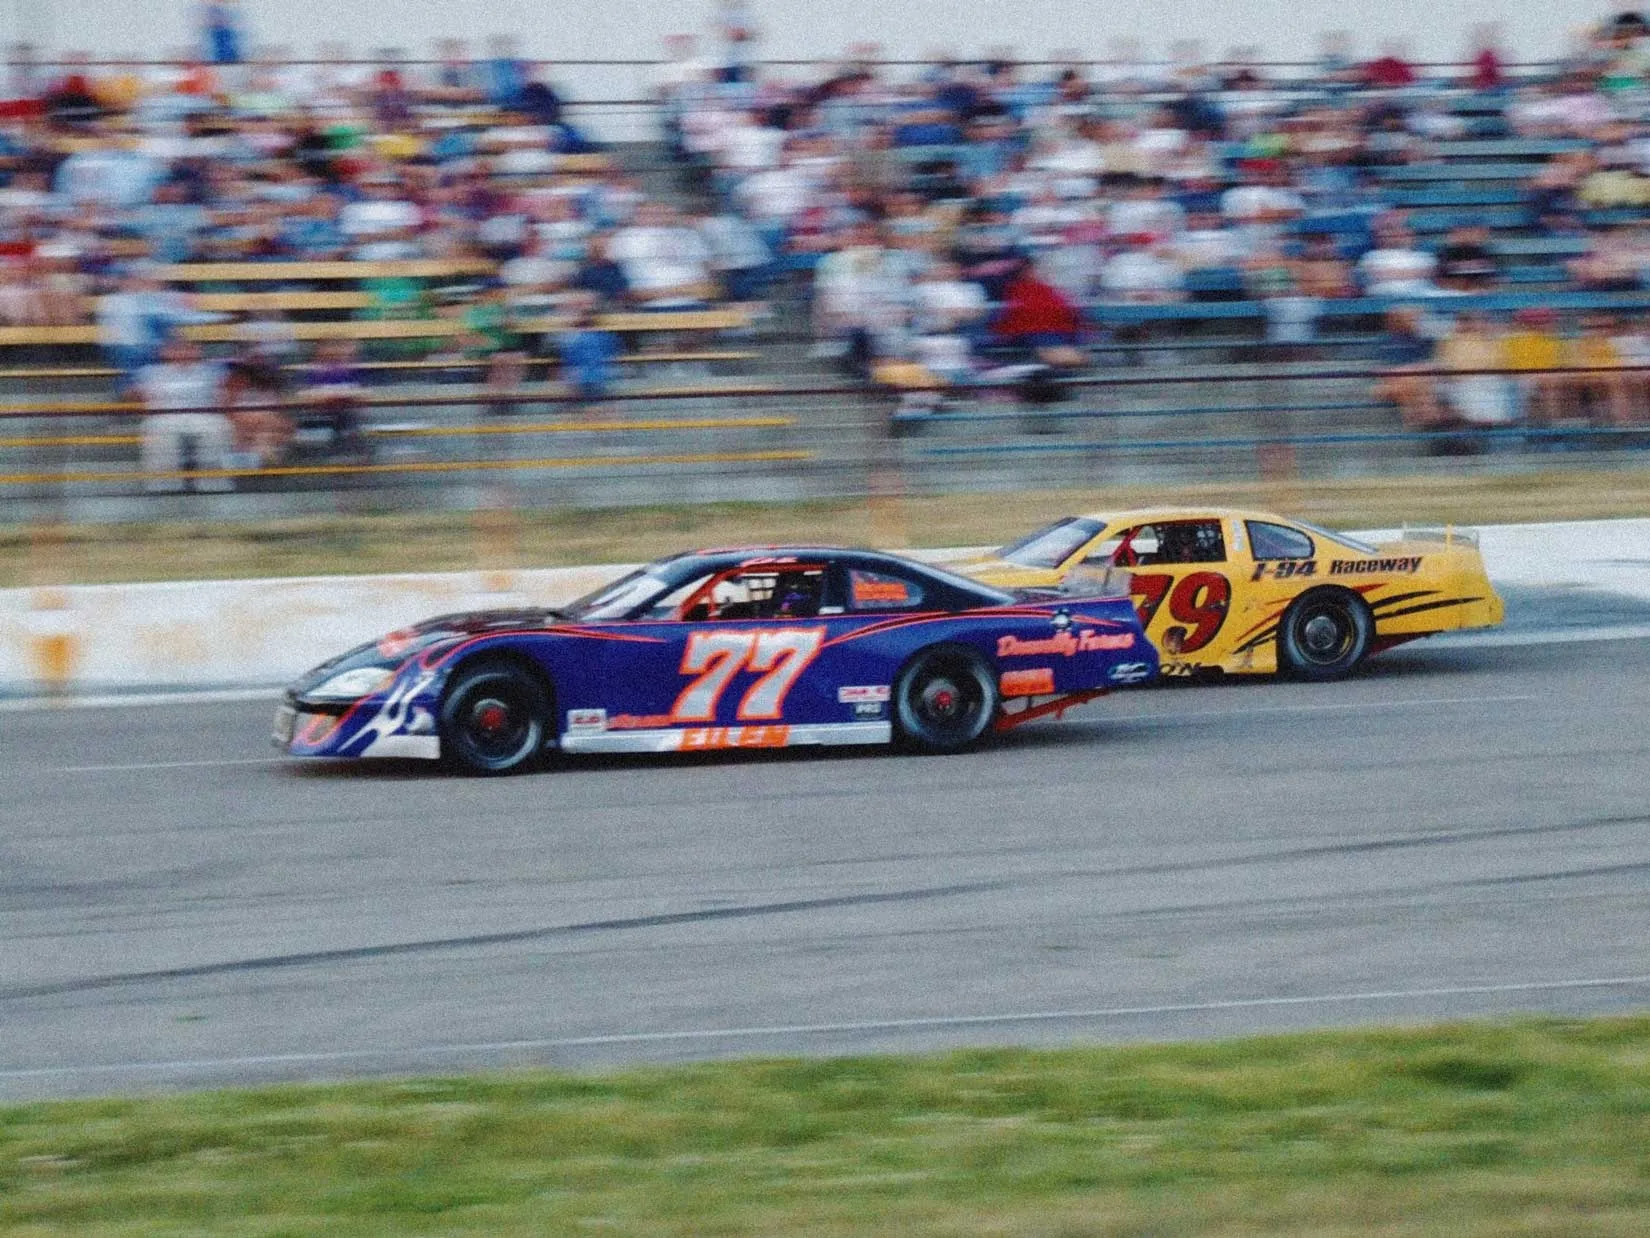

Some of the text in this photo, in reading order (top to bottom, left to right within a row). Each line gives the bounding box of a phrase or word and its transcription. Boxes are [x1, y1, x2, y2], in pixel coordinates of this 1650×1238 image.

[1250, 556, 1423, 582] I-94 Raceway
[1129, 571, 1232, 654] 79
[671, 625, 828, 723] 77
